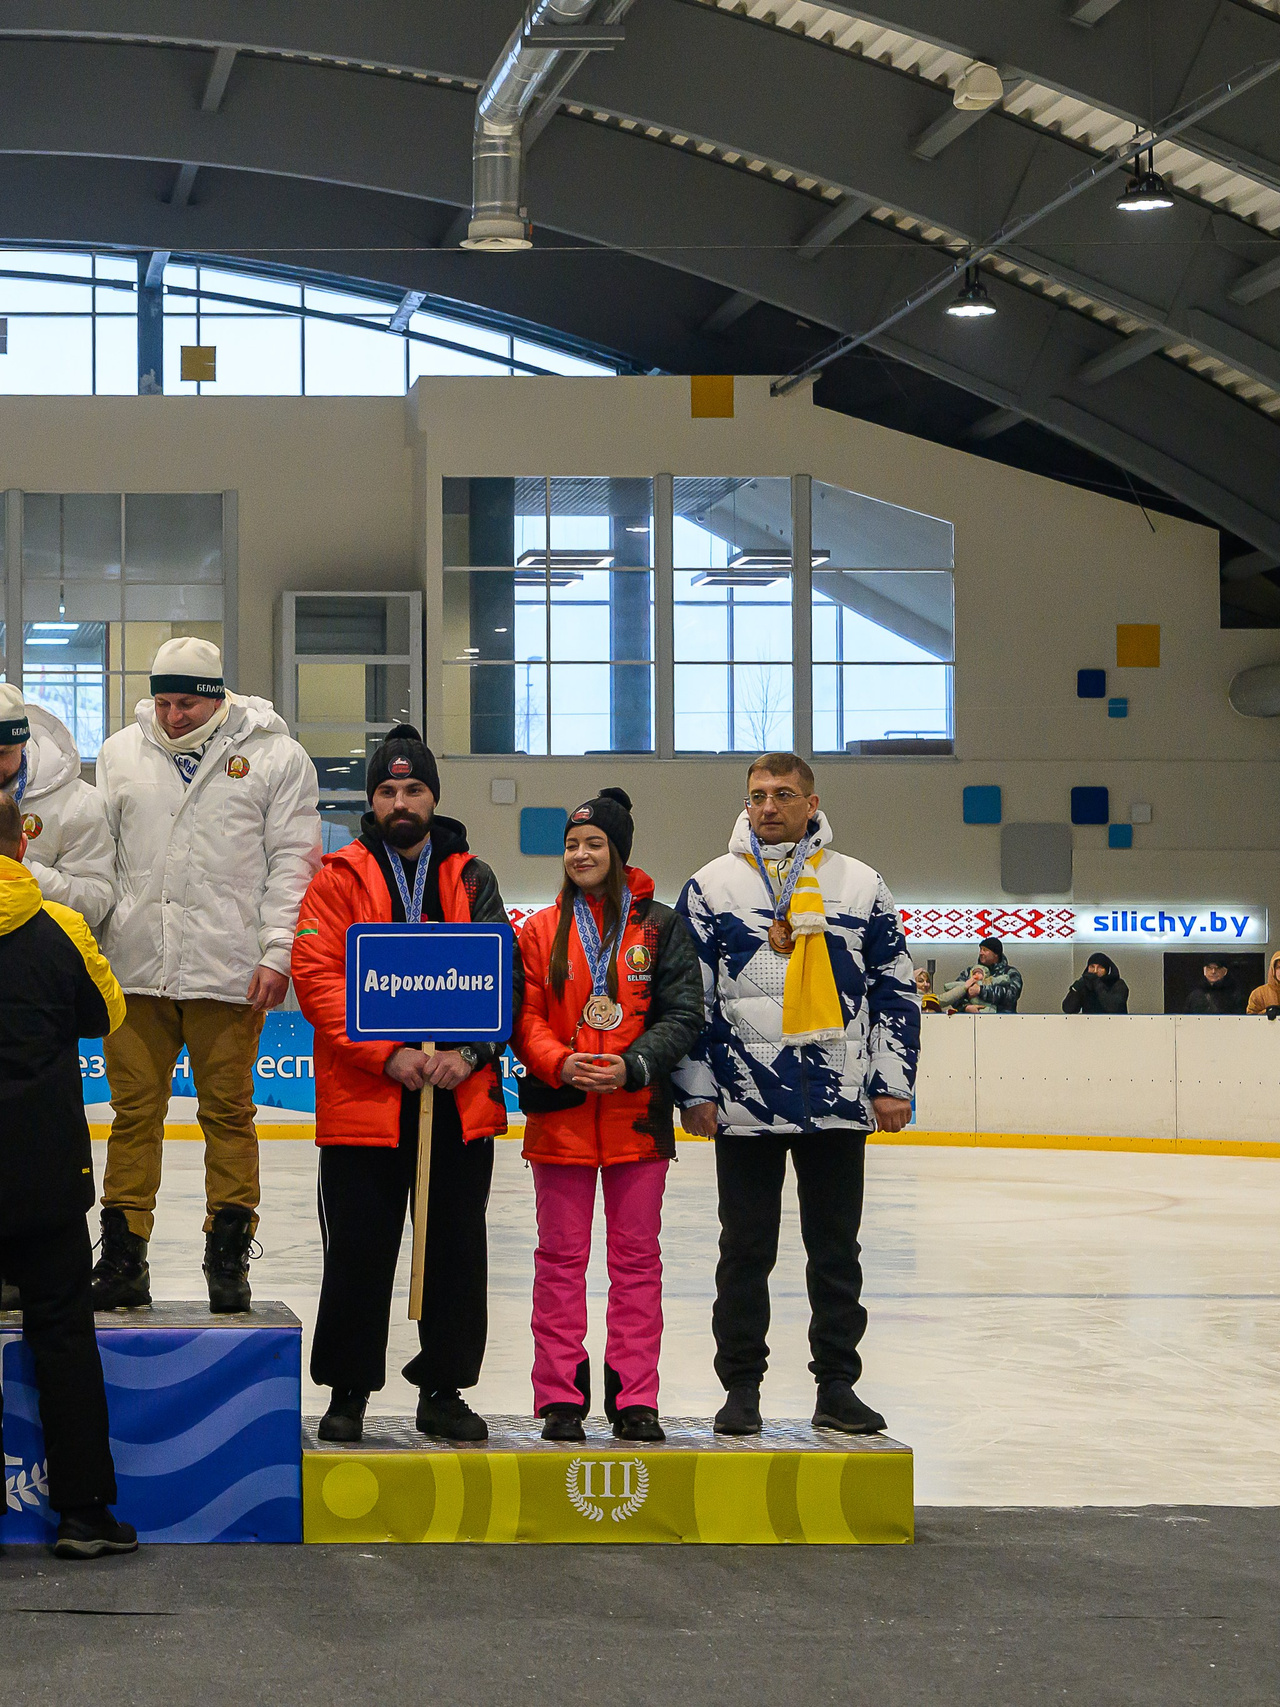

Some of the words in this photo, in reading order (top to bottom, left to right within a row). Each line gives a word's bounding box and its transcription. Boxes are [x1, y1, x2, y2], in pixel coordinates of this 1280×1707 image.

[1093, 910, 1250, 938] silichy.by
[364, 967, 494, 998] Агрохолдинг
[581, 1461, 636, 1498] III
